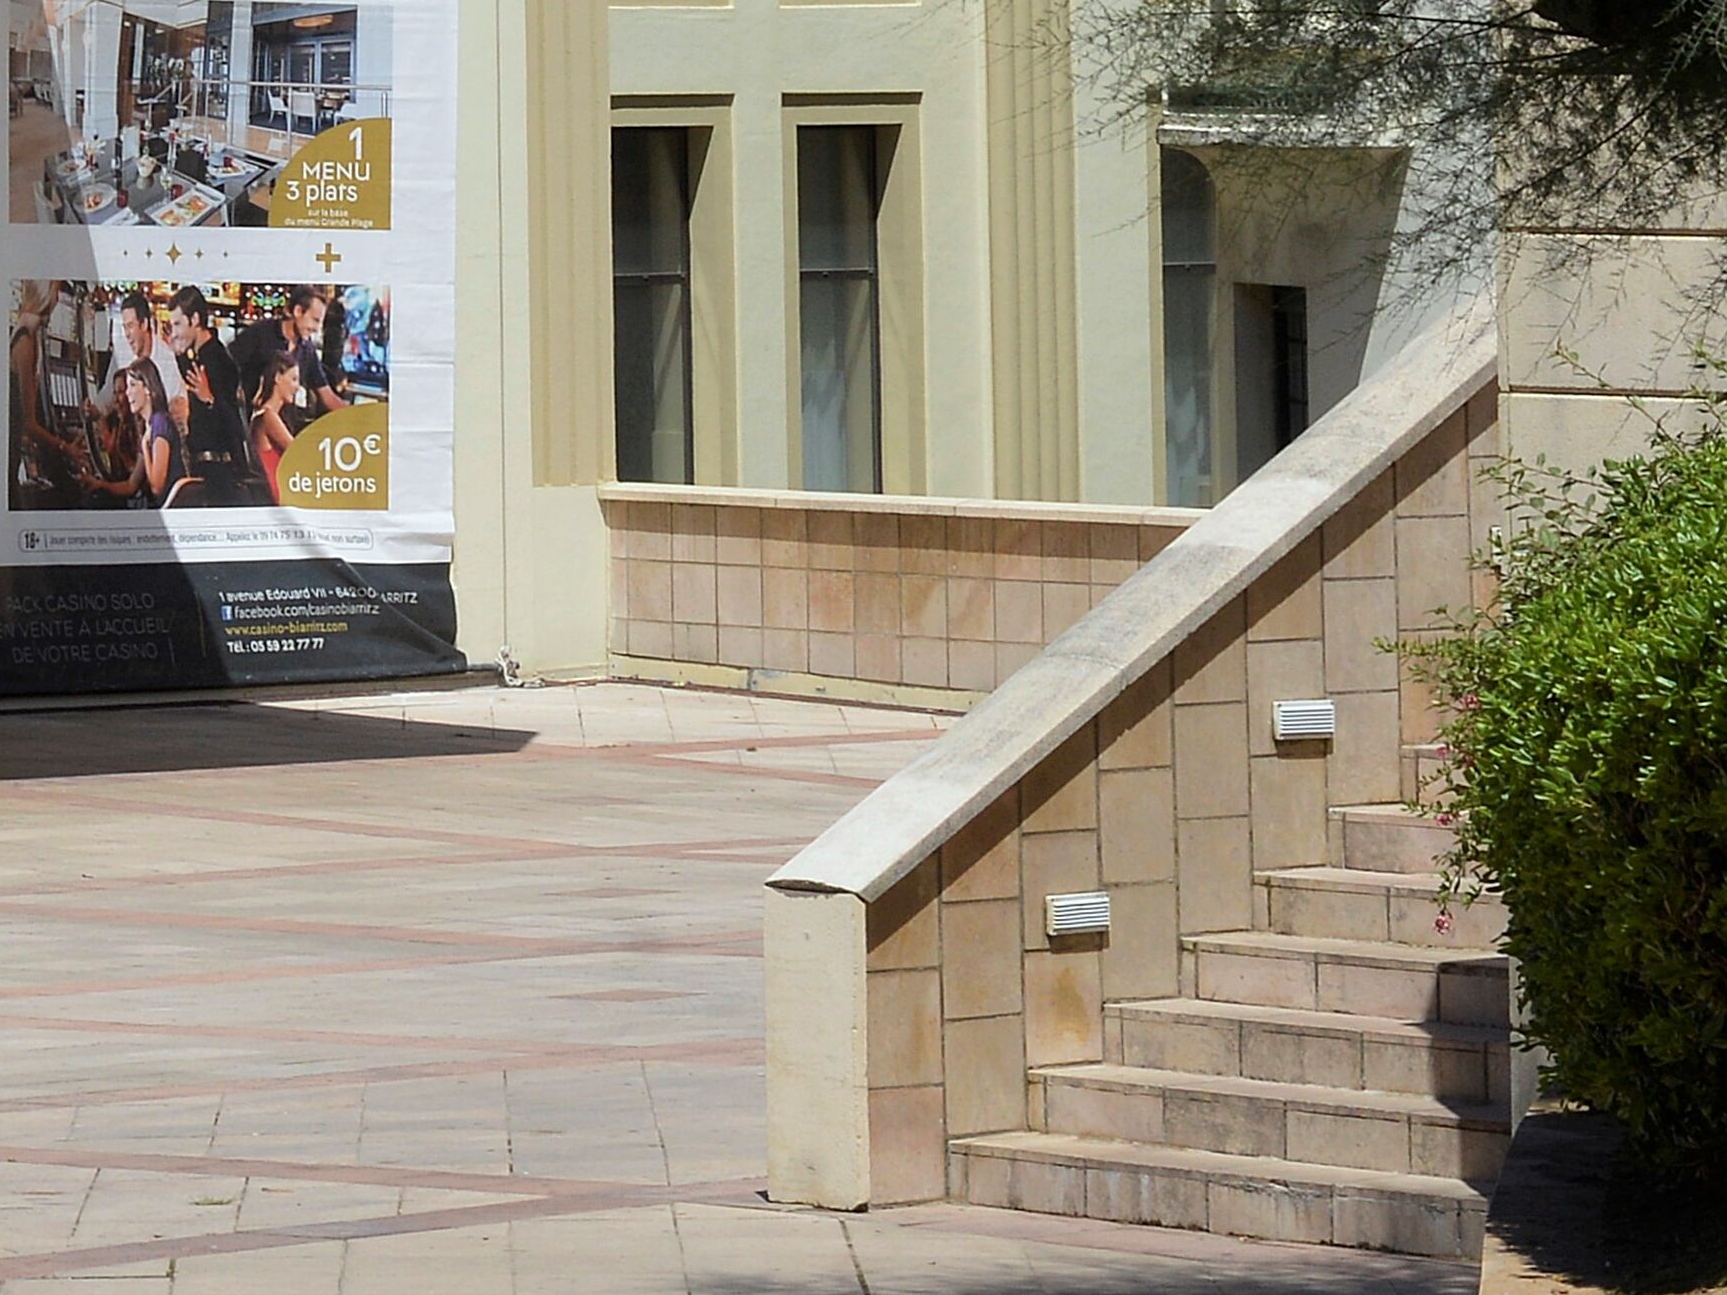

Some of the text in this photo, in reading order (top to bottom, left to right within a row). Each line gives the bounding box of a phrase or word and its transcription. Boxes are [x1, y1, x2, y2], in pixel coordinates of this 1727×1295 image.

[349, 127, 362, 160] 1
[303, 162, 370, 180] MENU
[286, 179, 357, 207] 3 plats
[319, 434, 381, 471] 10€
[289, 472, 376, 498] de jetons
[25, 532, 40, 549] 18+
[45, 594, 107, 612] CASINO
[111, 593, 155, 610] SOLO
[227, 592, 264, 602] avenue
[266, 589, 310, 601] Edouard
[313, 588, 327, 599] VII
[336, 587, 377, 598] 64200
[234, 604, 380, 620] facebook.com/casinobiarritz
[18, 620, 73, 638] VENTE
[225, 622, 348, 635] www.casino-biarritz.com
[12, 642, 158, 663] DE VOTRE CASINO
[282, 639, 295, 651] 22
[297, 638, 310, 649] 77
[312, 637, 324, 649] 77
